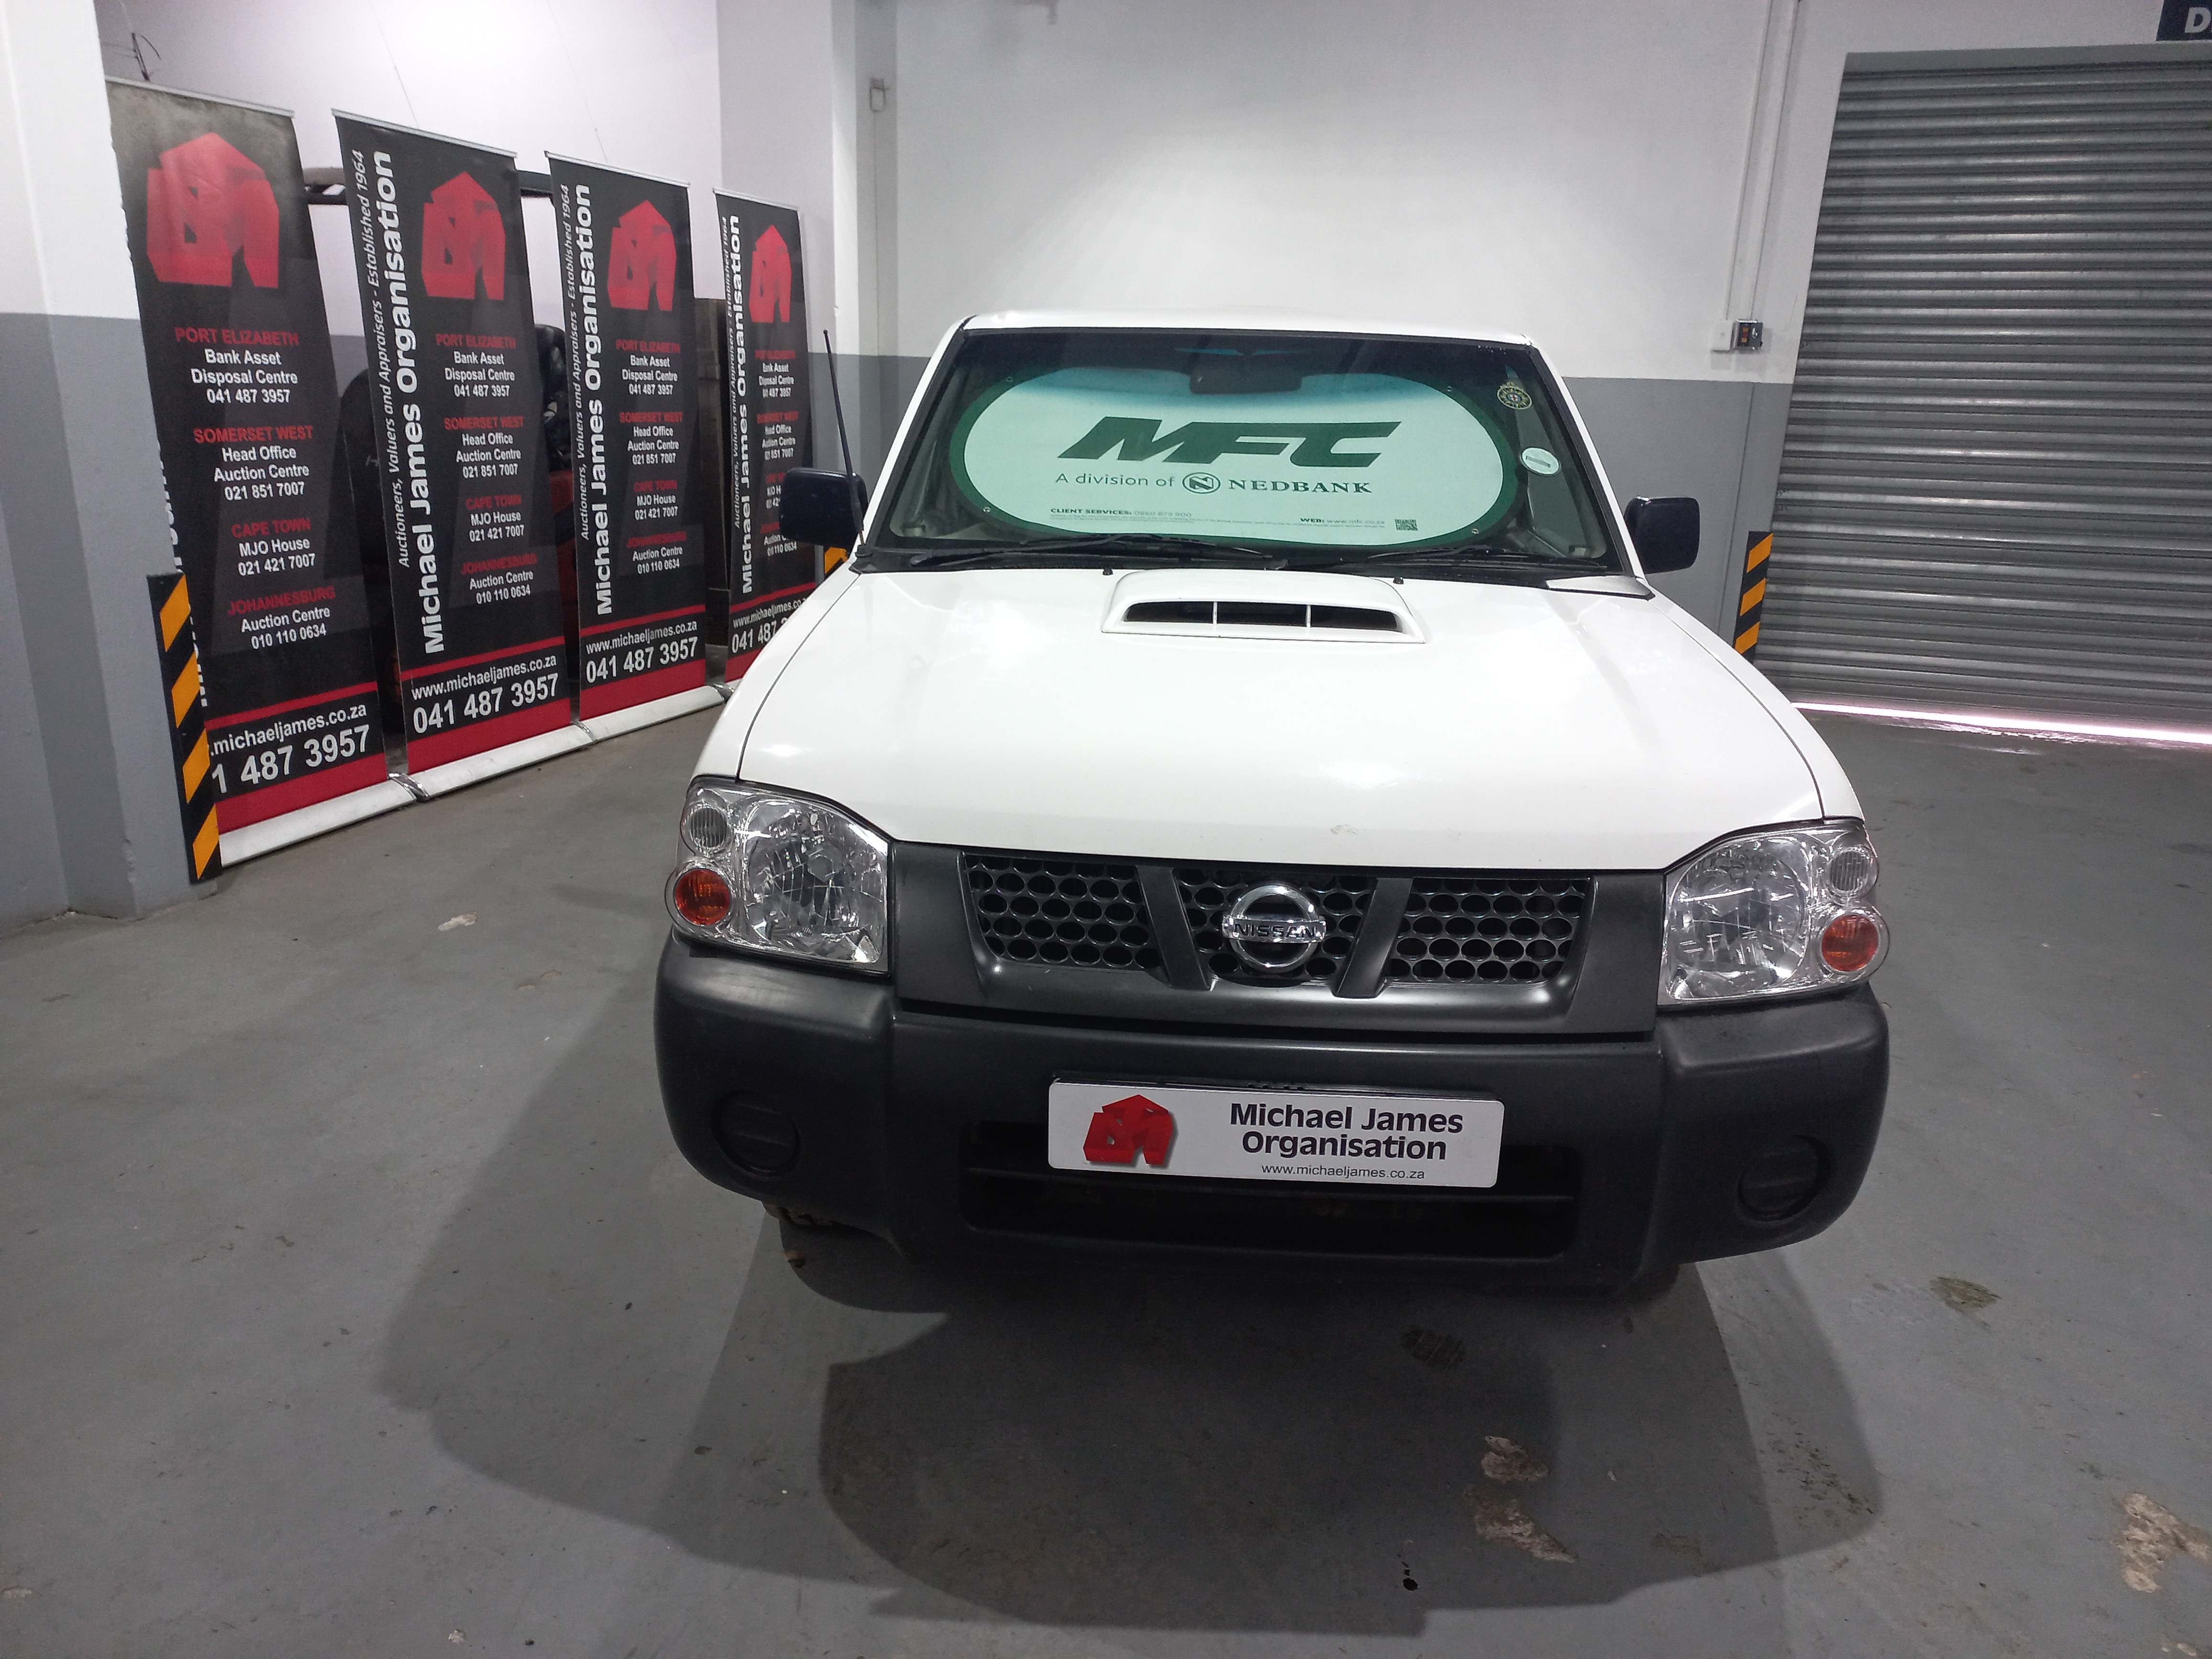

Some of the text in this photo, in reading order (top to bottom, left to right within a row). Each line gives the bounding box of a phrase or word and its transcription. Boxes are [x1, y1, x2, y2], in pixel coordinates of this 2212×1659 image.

[2185, 7, 2211, 33] D
[175, 327, 299, 346] PORT ELIZABETH
[435, 333, 464, 347] PORT
[204, 348, 282, 365] Bank Asset
[351, 149, 410, 568] Auctioneers, Valuers and Appraisers Established 1964
[453, 351, 505, 365] Bank Asset
[560, 183, 590, 541] Auctioneers, Valuers and Appraisers Established 1964
[650, 355, 670, 367] Asset
[191, 368, 299, 387] Disposal Centre
[444, 367, 516, 383] Disposal Centre
[622, 369, 678, 383] Disposal Centre
[206, 388, 290, 404] 041 487 3957
[454, 384, 510, 398] 041 487 3957
[629, 383, 674, 396] 041 487 3957
[373, 150, 445, 654] Michael James Organisation
[575, 184, 613, 616] Michael James Organisation
[193, 425, 313, 443] SOMERSET WEST
[462, 431, 514, 446] Head Office
[652, 425, 674, 437] Office
[627, 439, 680, 452] Auction Centre
[739, 404, 751, 489] James
[1057, 416, 1402, 467] MFC
[222, 445, 297, 462] Head Office
[456, 448, 521, 463] Auction Centre
[632, 453, 644, 465] 021
[660, 453, 676, 464] 7007
[214, 464, 310, 483] Auction Centre
[462, 463, 519, 479] 021 851 7007
[224, 481, 305, 501] 021 851 7007
[1055, 473, 1372, 494] A division of NEDBANK
[653, 494, 676, 505] House
[470, 511, 521, 526] MJO House
[635, 506, 678, 521] 021 421 7007
[231, 517, 311, 538] CAPE TOWN
[468, 524, 525, 543] 021 421 7007
[239, 538, 310, 557] MJO House
[632, 546, 683, 562] Auction Centre
[741, 495, 753, 595] Michael
[238, 553, 316, 576] 021 421 7007
[637, 557, 680, 574] 010 110 0634
[469, 570, 534, 590] Auction Centre
[228, 585, 336, 616] JOHANNESBURG
[476, 584, 531, 605] 010 110 0634
[241, 607, 331, 632] Auction Centre
[251, 622, 327, 650] 010 110 0634
[586, 620, 698, 655] www.michaeljames.co.za
[731, 619, 777, 654] 041 487
[586, 636, 698, 683] 041 487 3957
[411, 654, 557, 701] www.michaeljames.co.za
[413, 672, 559, 734] 041 487 3957
[210, 704, 367, 756] .michaeljames.co.za
[240, 744, 293, 785] 487
[304, 724, 370, 767] 3957
[1234, 923, 1317, 939] NISSAN
[1230, 1102, 1464, 1134] Michael James
[1242, 1130, 1447, 1161] Organisation
[1261, 1164, 1425, 1180] www.michaeljames.co.za
